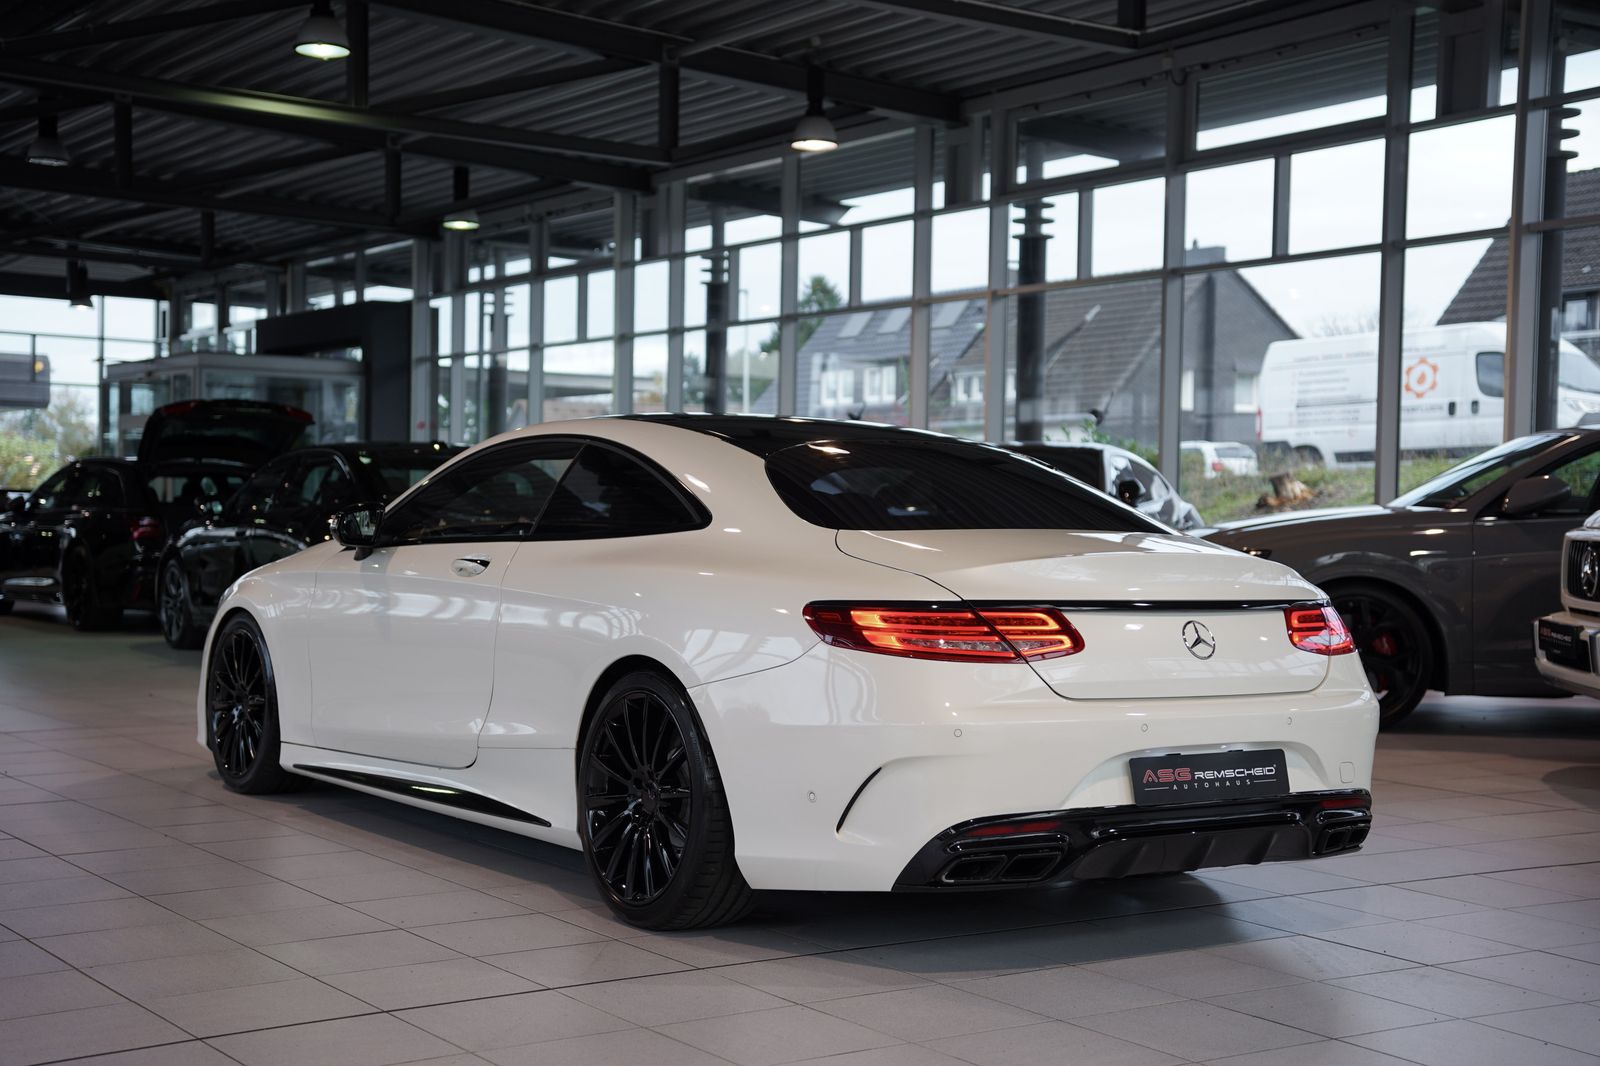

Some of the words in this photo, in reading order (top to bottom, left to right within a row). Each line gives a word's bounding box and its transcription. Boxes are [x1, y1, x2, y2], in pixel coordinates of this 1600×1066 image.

[1143, 768, 1192, 783] ASG
[1194, 766, 1276, 780] REMSCHEID
[1172, 779, 1251, 790] AUTOHAUS
